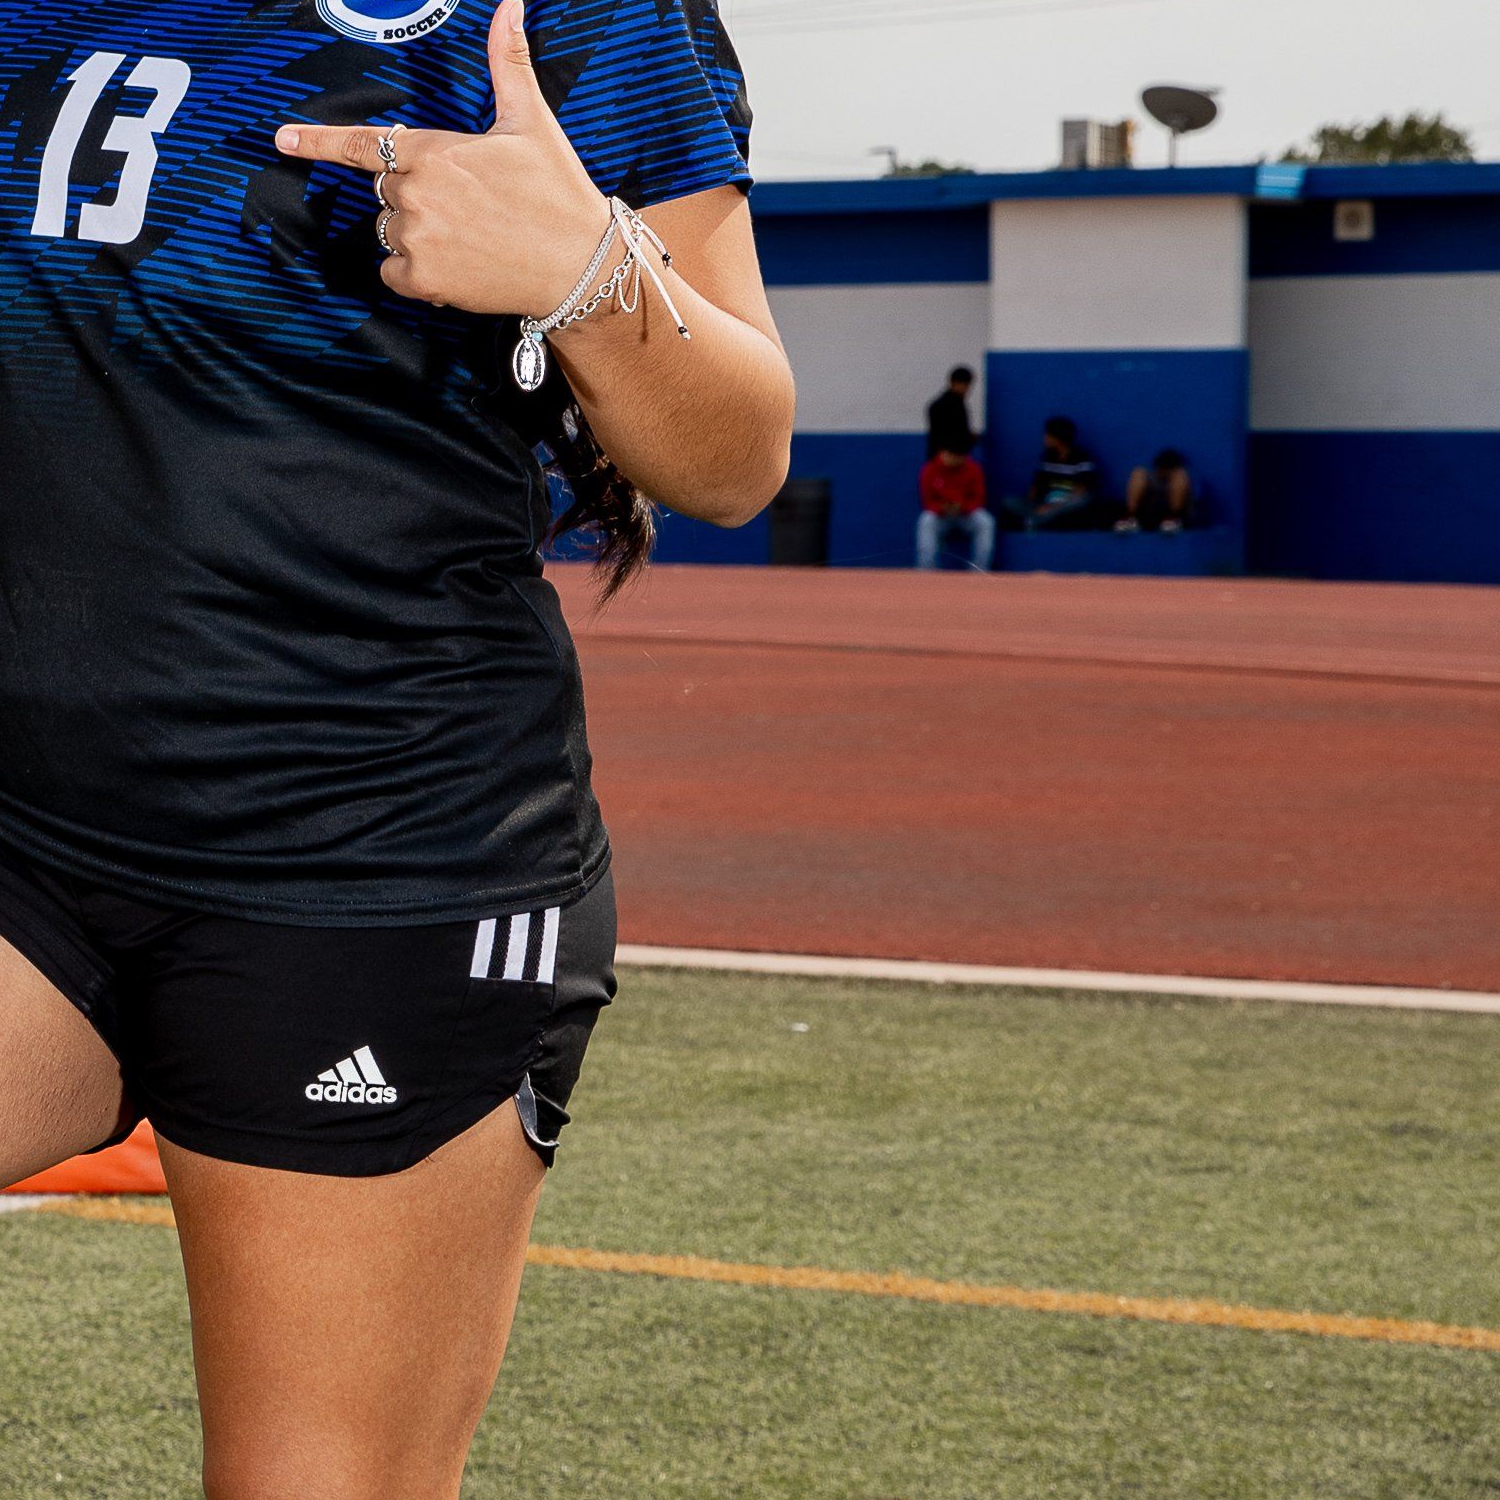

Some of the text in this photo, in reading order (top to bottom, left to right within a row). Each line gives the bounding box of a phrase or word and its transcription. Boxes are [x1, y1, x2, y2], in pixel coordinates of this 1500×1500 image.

[383, 7, 447, 40] SOCCER
[30, 51, 191, 244] 13
[305, 1078, 397, 1105] adidas
